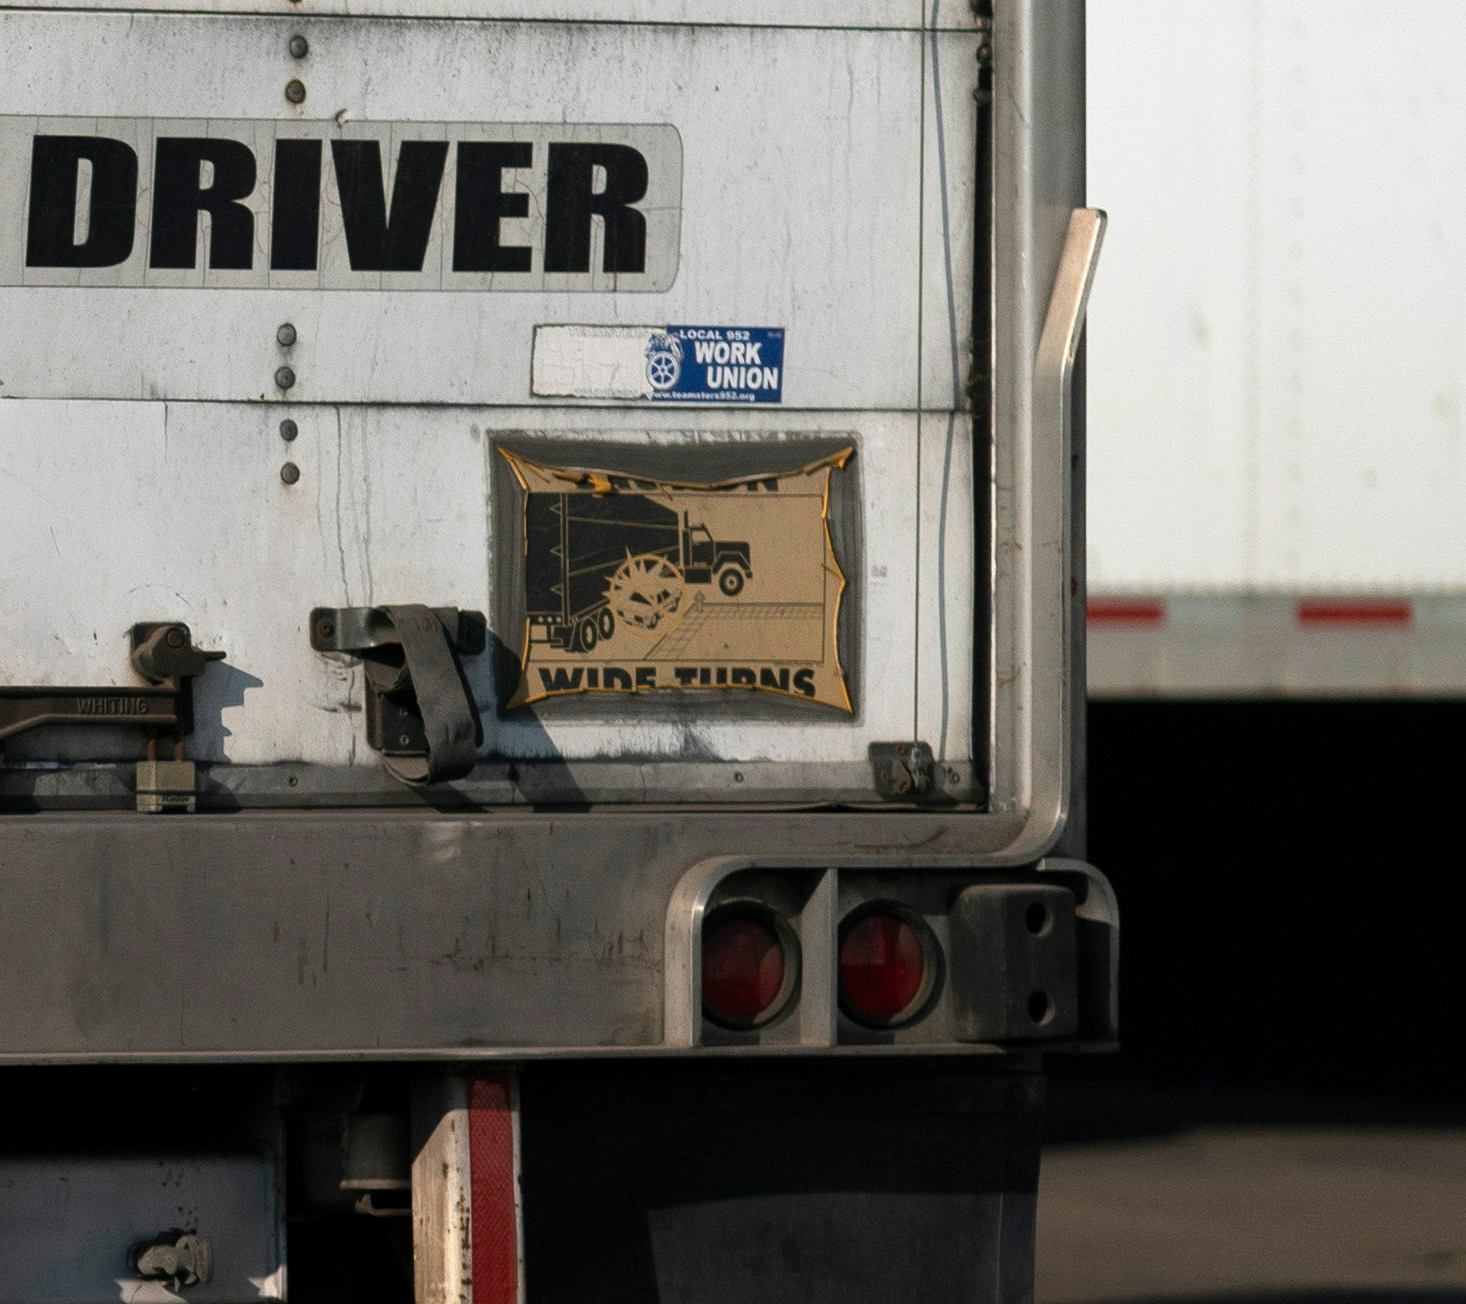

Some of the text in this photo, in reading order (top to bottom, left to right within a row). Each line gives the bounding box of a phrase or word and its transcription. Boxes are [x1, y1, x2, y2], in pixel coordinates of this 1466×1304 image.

[25, 133, 651, 275] DRIVER
[680, 329, 750, 341] LOCAL 952
[694, 341, 762, 365] WORK
[707, 366, 778, 389] UNION
[76, 697, 148, 714] WHITING
